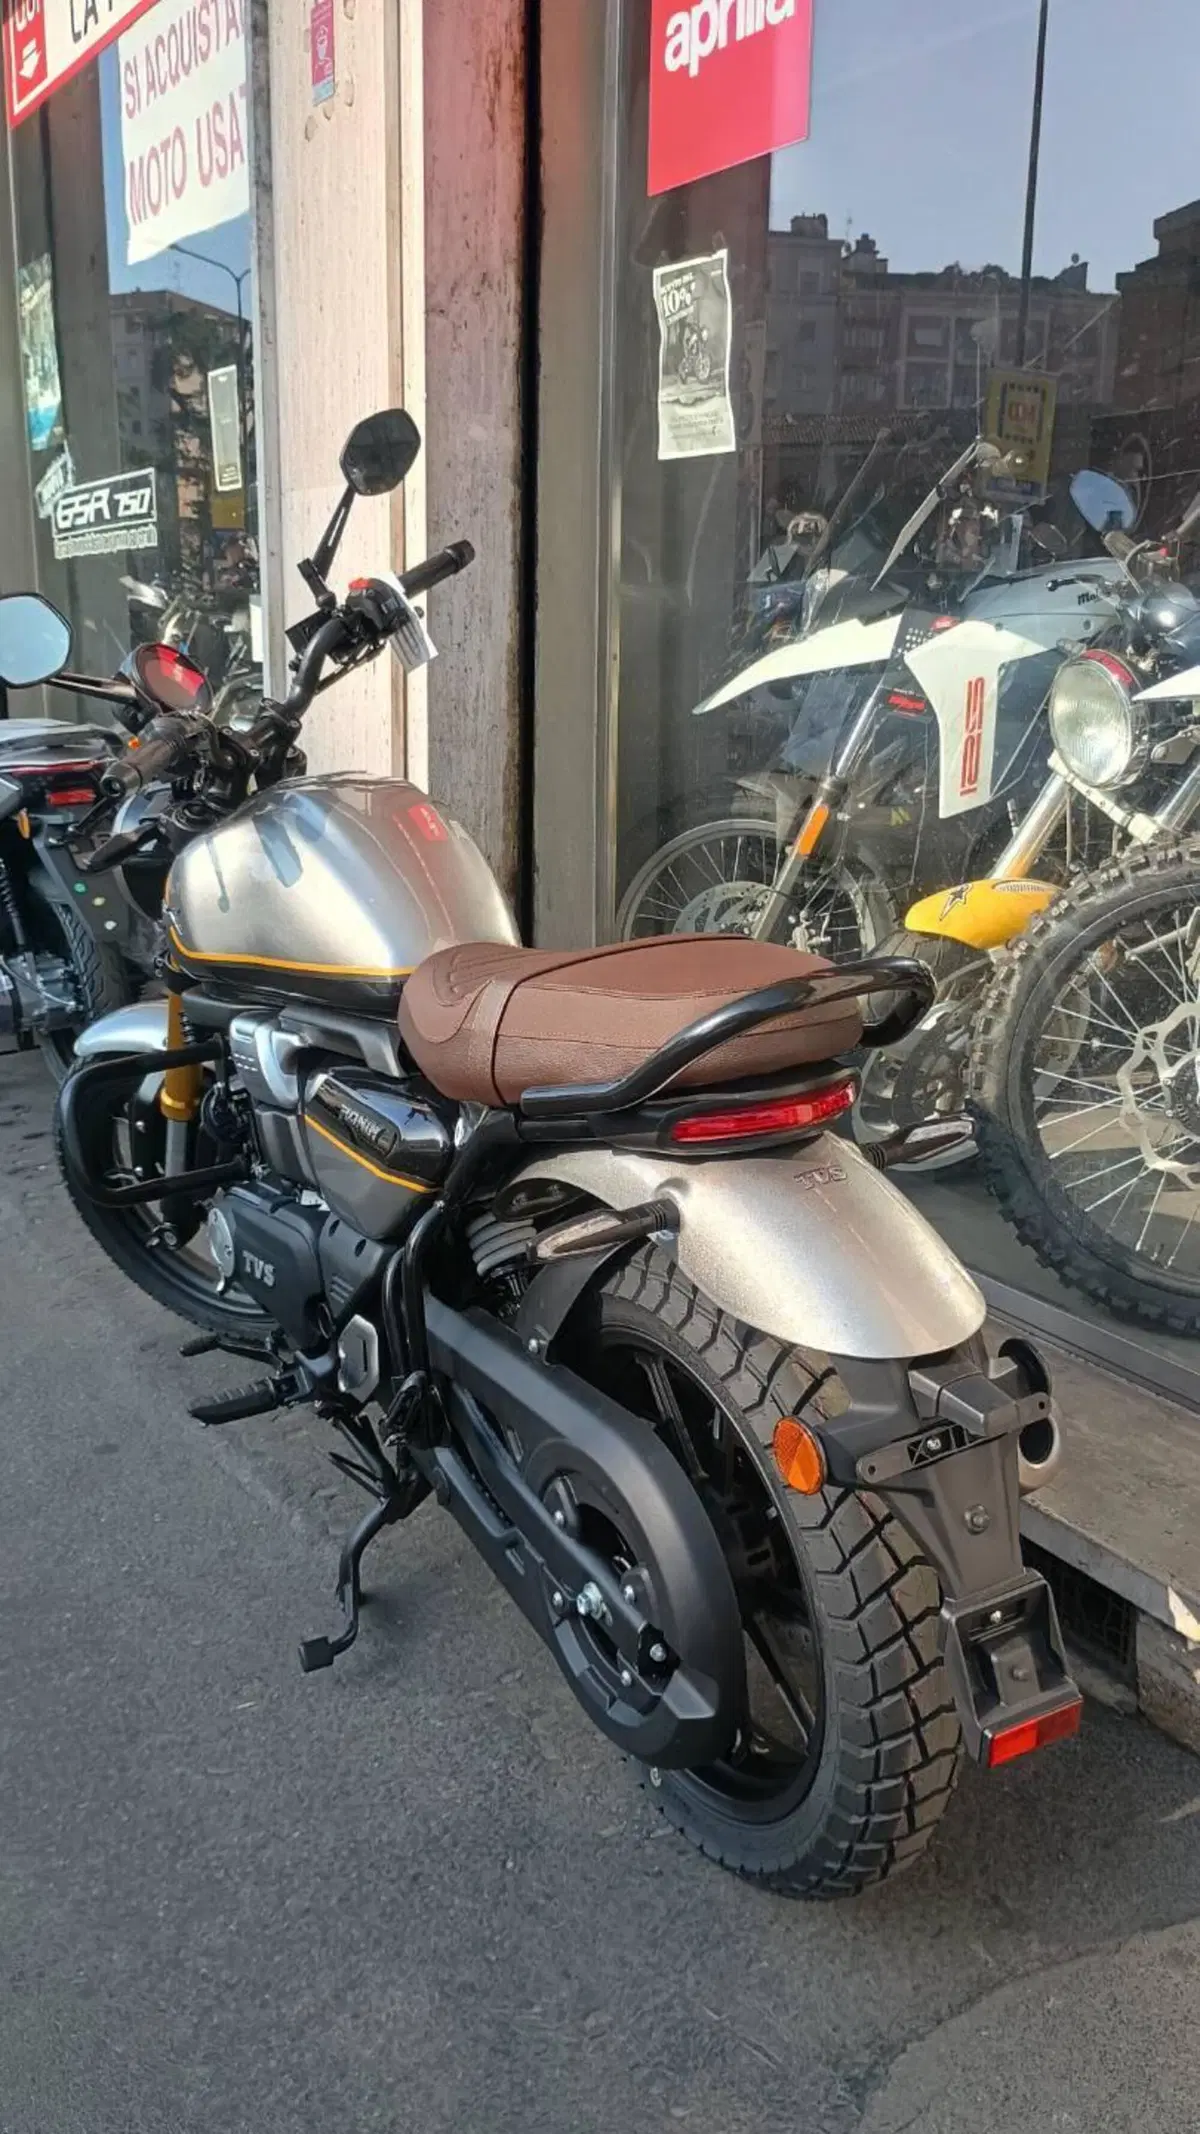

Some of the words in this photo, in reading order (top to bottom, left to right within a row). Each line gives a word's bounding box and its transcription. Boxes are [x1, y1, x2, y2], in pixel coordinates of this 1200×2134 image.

[123, 54, 142, 119] SI
[129, 125, 187, 226] MOTO
[113, 487, 151, 517] 750
[793, 1164, 848, 1191] TVS
[242, 1249, 275, 1287] TVS
